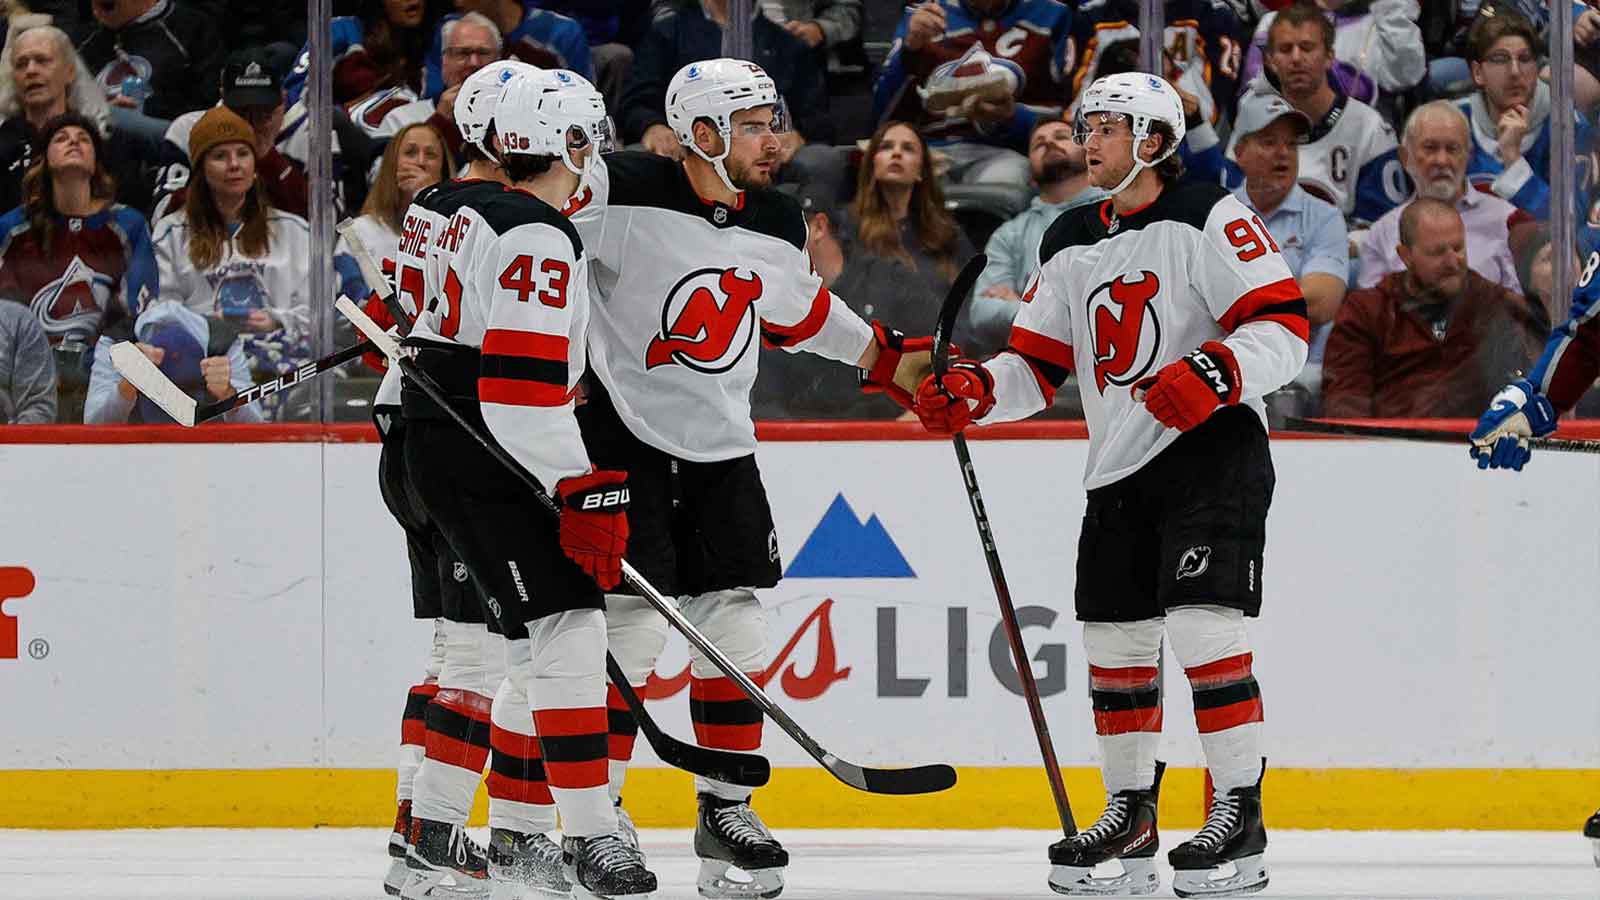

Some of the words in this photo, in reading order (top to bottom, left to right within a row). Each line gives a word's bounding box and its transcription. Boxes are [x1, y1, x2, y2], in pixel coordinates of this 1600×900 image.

[503, 132, 518, 150] 43
[1331, 145, 1349, 183] C
[1224, 215, 1281, 263] 91
[498, 254, 571, 310] 43
[238, 362, 318, 403] TRUE
[877, 605, 1068, 699] LIG
[1122, 829, 1151, 854] CCM
